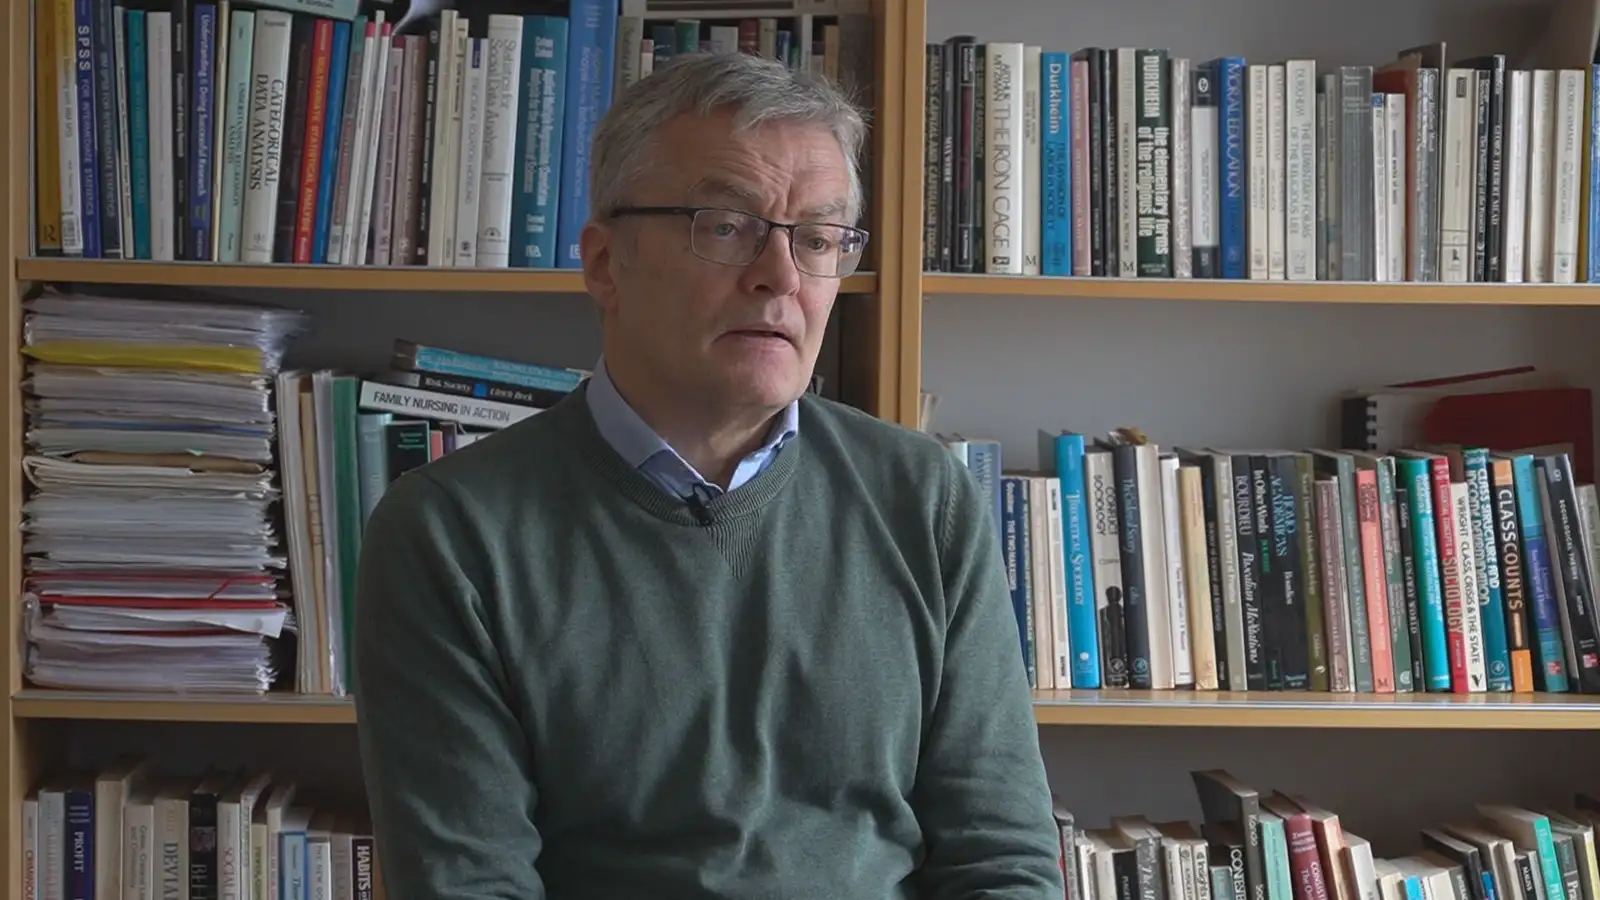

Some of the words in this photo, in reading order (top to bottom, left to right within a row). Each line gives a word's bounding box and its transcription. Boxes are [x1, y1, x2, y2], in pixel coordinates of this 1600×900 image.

[78, 25, 91, 71] SPSS
[197, 14, 211, 77] Understanding
[196, 87, 207, 112] Doing
[255, 73, 269, 114] DATA
[1048, 63, 1063, 134] Durkheim
[1144, 56, 1160, 118] DURKHEIM
[1227, 63, 1242, 116] MORAL
[264, 78, 284, 188] CATEGORICAL
[992, 103, 1011, 140] THE
[1139, 126, 1153, 138] of
[1155, 127, 1169, 145] the
[249, 119, 266, 192] ANALYSIS
[992, 144, 1011, 190] IRON
[1139, 141, 1154, 161] the
[1226, 118, 1241, 198] EDUCATION
[1136, 163, 1153, 214] religious
[1153, 147, 1169, 214] elementary
[992, 196, 1011, 249] CAGE
[1139, 217, 1154, 236] life
[1155, 218, 1169, 254] forms
[372, 390, 411, 407] FAMILY
[412, 397, 459, 415] NURSING
[460, 403, 470, 416] IN
[472, 406, 512, 423] ACTION
[1094, 474, 1106, 537] SOCIOLOGY
[1235, 475, 1253, 537] BOURDIEU
[1478, 468, 1491, 501] CLASS
[1455, 496, 1471, 538] WRIGHT
[1481, 504, 1498, 563] STRUCTURE
[1498, 489, 1524, 611] CLASSCOUNTS
[1443, 558, 1465, 635] SOCIOLOGY
[1463, 576, 1477, 606] CRISIS
[1487, 565, 1501, 590] AND
[1467, 607, 1477, 615] &
[1468, 616, 1480, 634] THE
[1470, 636, 1483, 664] STATE
[73, 831, 85, 873] PROFIT
[356, 845, 371, 891] HABITS
[1566, 880, 1580, 900] Pra
